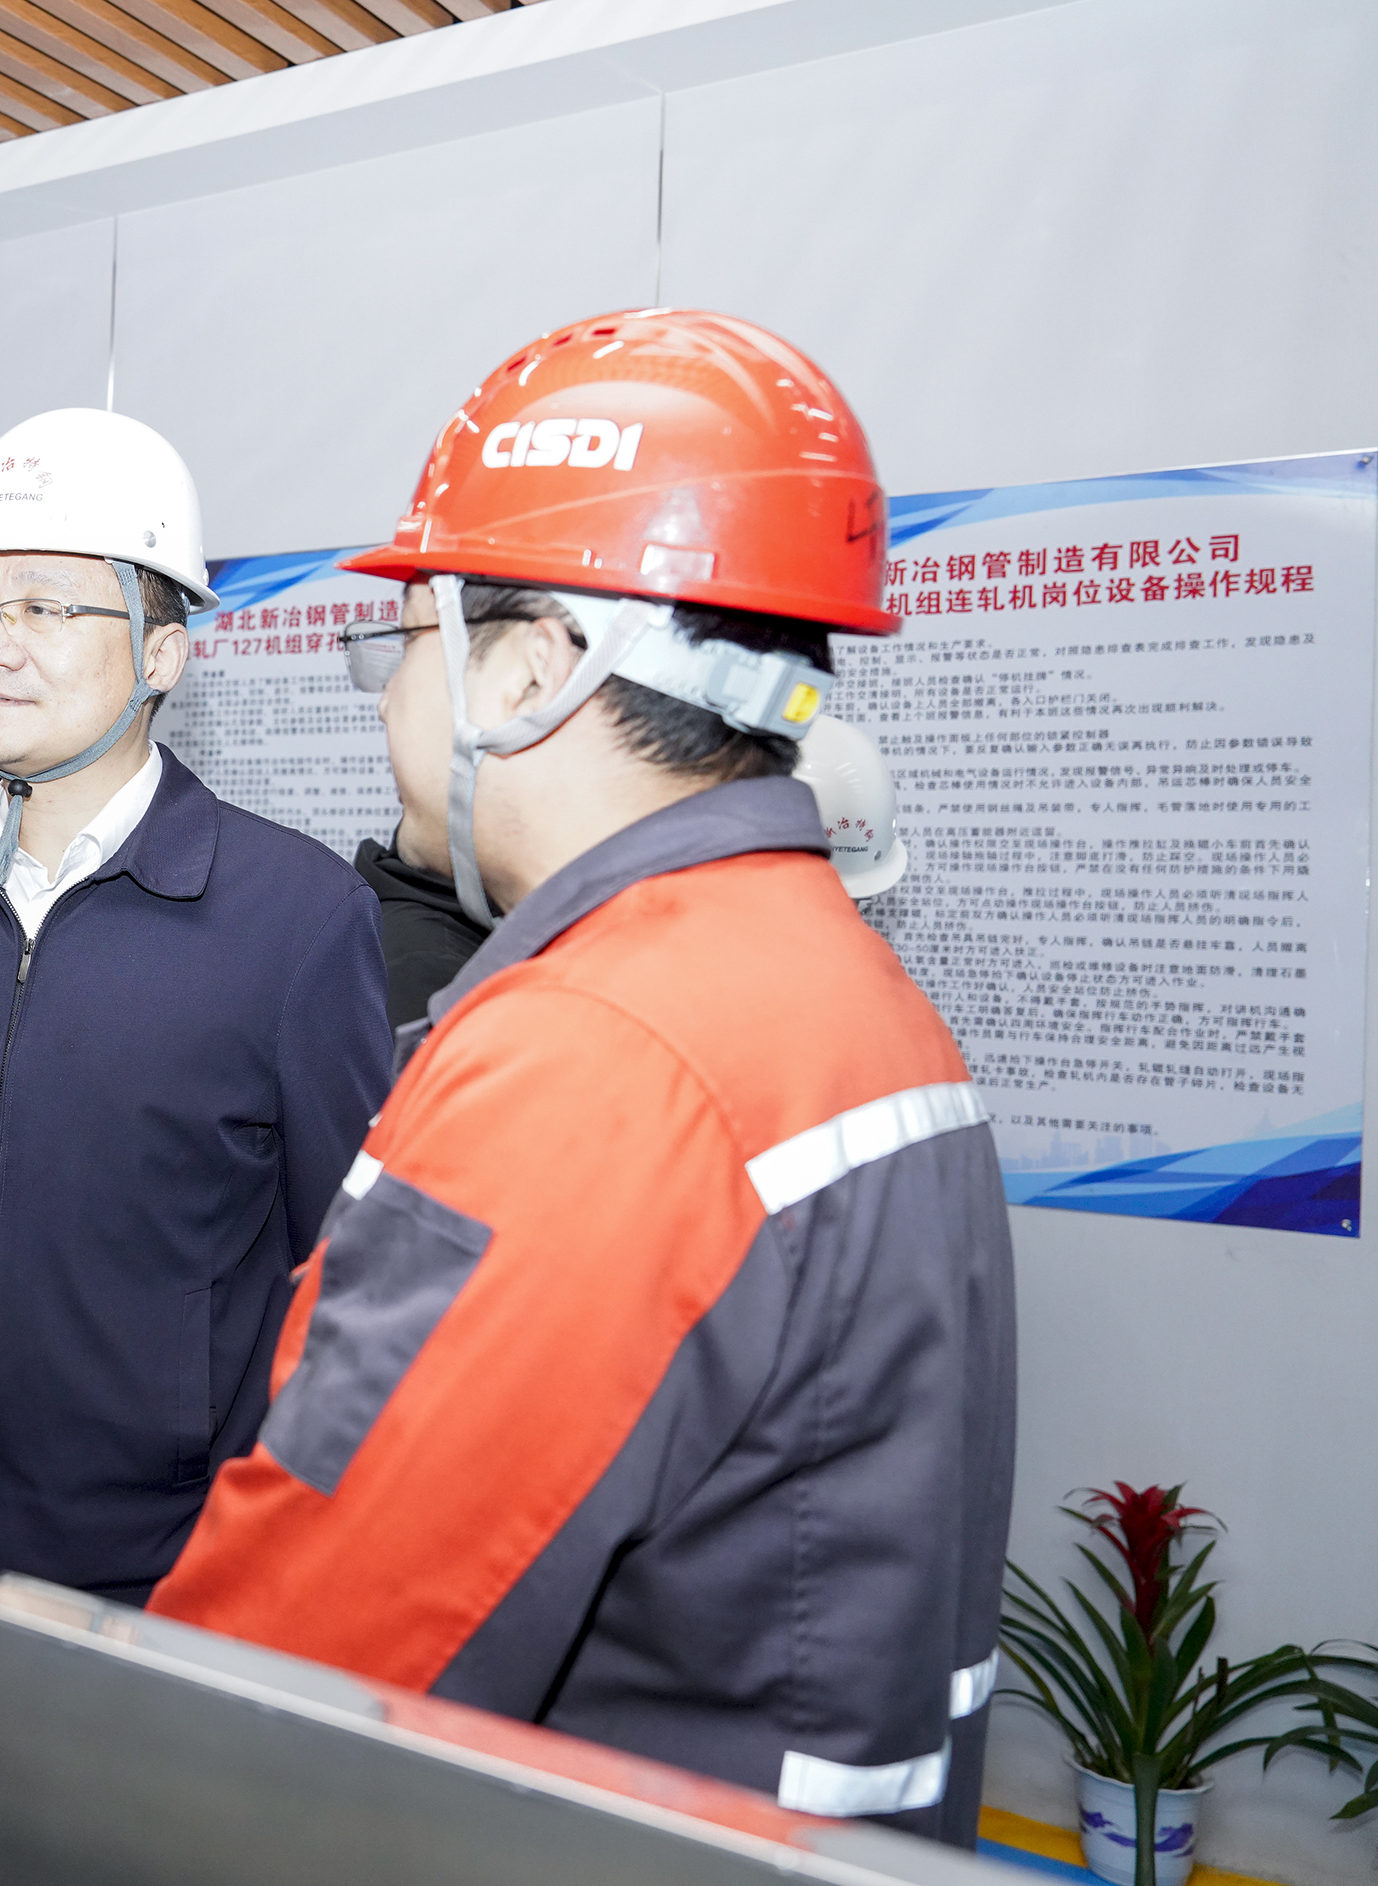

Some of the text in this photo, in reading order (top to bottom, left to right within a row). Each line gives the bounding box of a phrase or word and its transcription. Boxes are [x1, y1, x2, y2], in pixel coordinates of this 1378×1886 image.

[481, 418, 644, 471] CISDI
[884, 534, 1240, 587] 新冶钢管制造有限公司
[887, 564, 1314, 616] 机组连轧机岗位设备操作规程
[214, 600, 399, 633] 湖北新冶钢管制造
[188, 632, 344, 661] 轧厂127机组穿孔
